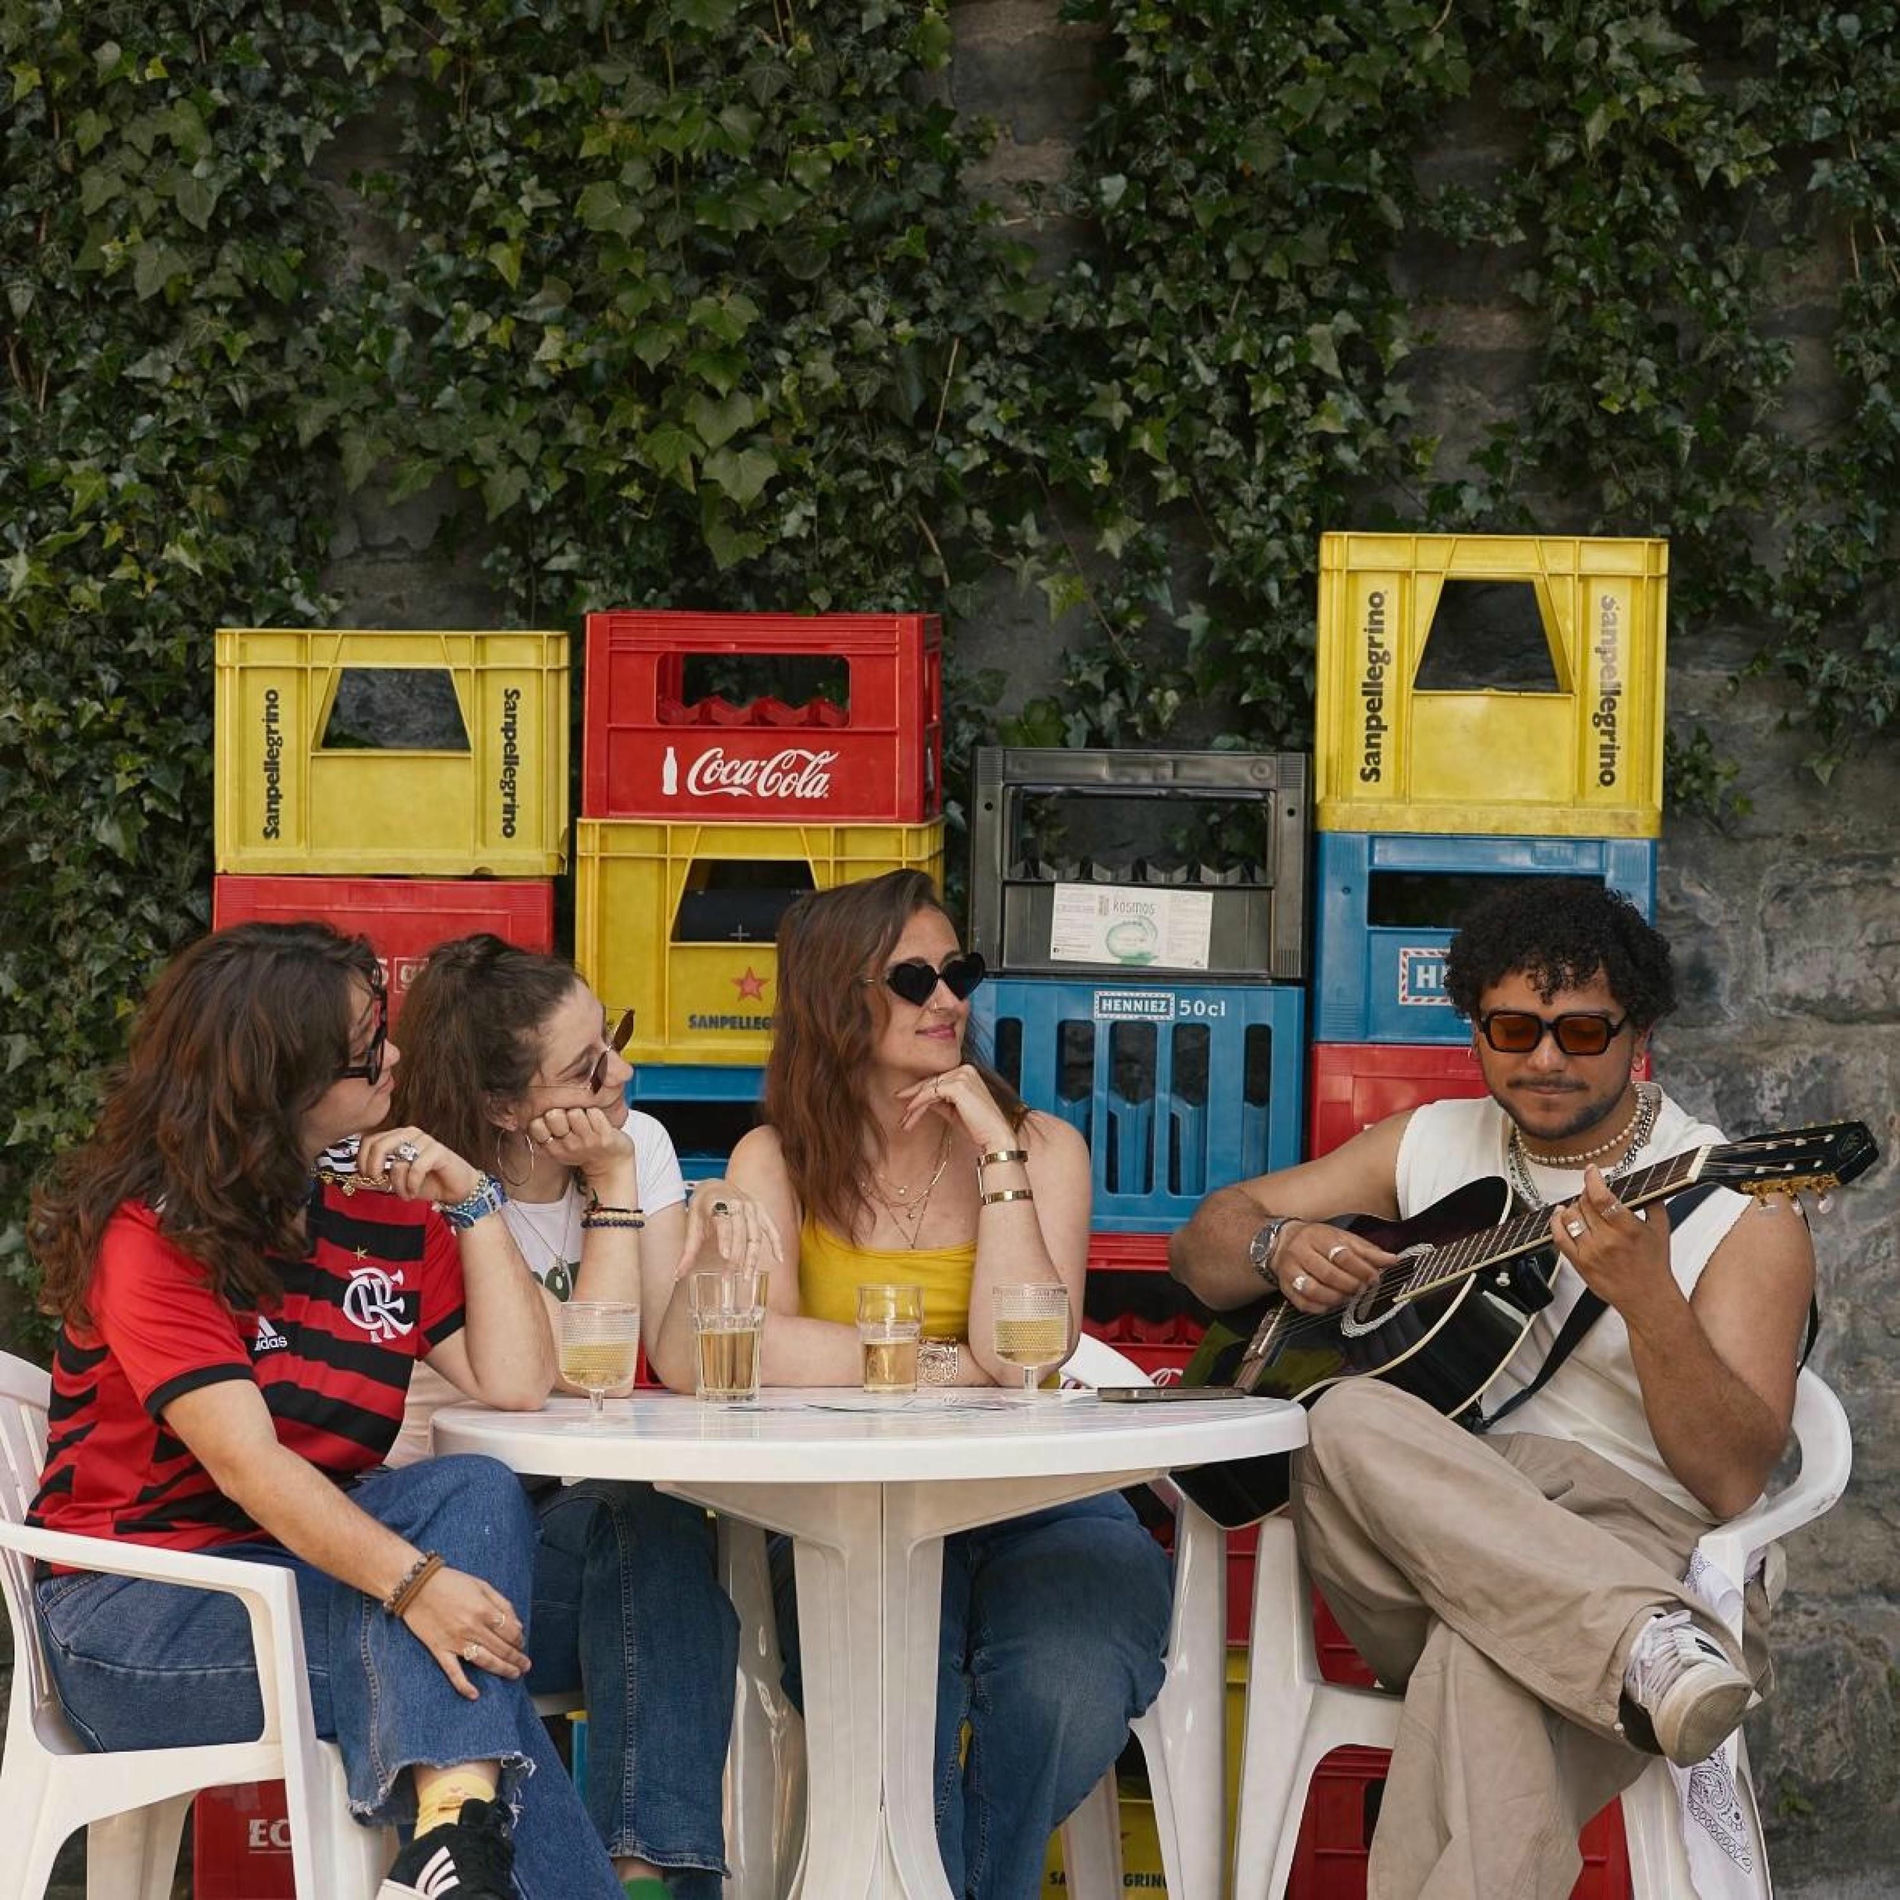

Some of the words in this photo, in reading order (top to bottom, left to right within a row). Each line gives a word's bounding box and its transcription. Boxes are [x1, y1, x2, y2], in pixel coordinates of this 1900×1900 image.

[1360, 590, 1391, 783] Sanpellegrino
[263, 689, 283, 839] Sanpellegrino
[500, 688, 521, 839] Sanpellegrino
[687, 747, 839, 799] Coca-Cola
[688, 1014, 772, 1031] SANPELLEG
[1101, 998, 1168, 1013] HENNIEZ
[1179, 1000, 1226, 1017] 50cl
